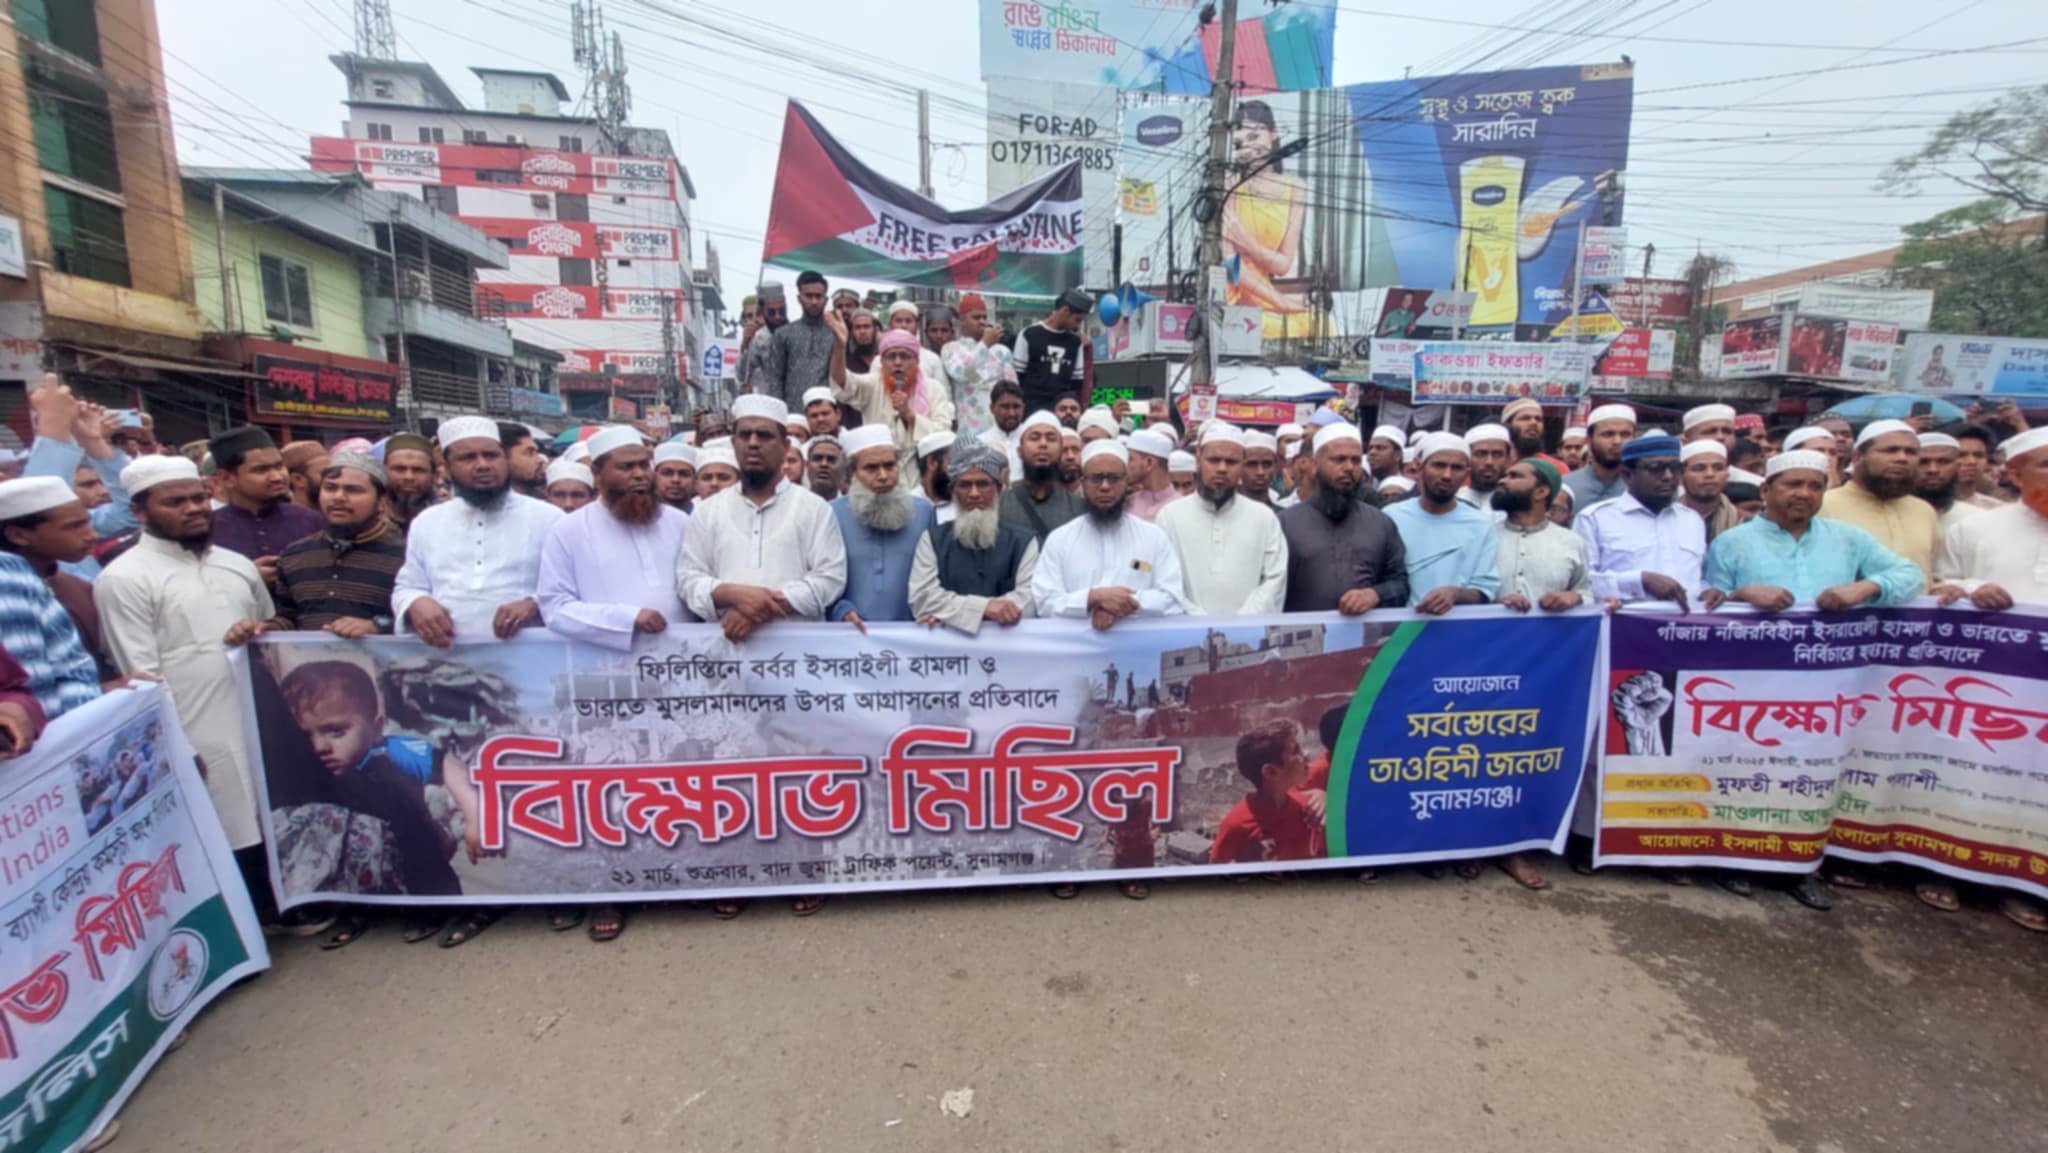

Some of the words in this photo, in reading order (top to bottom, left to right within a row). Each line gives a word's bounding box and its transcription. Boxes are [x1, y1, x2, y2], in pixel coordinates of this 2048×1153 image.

[1452, 96, 1469, 113] ও
[1475, 91, 1534, 112] সতেজ
[1539, 87, 1576, 115] ত্বক
[1019, 113, 1098, 138] FOR-AD
[1452, 112, 1536, 143] সারাদিন
[618, 162, 667, 178] PREMIER
[623, 231, 669, 246] PREMIER
[877, 211, 947, 253] FREE
[1715, 619, 1806, 642] নজিরবিহীন
[1882, 620, 1932, 638] হামলা
[1937, 622, 1954, 637] ও
[1961, 623, 2032, 645] ভারতে
[637, 653, 742, 682] ফিলিস্তিনে
[749, 652, 797, 679] বর্বর
[804, 650, 899, 680] ইসরাইলী
[908, 655, 971, 678] হামলা
[979, 655, 997, 675] ও
[1793, 643, 1855, 664] নির্বিচারে
[1907, 640, 1984, 664] প্রতিবাদে
[1432, 674, 1522, 694] আয়োজনে
[574, 698, 645, 718] ভারতে
[654, 693, 788, 720] মুসলমানদের
[794, 690, 847, 713] উপর
[853, 689, 961, 712] আগ্রাসনের
[969, 683, 1061, 711] প্রতিবাদে
[1887, 672, 2048, 753] মিছি
[1368, 743, 1481, 784] তাওহিদী
[1485, 747, 1565, 777] জনতা
[471, 735, 868, 852] বিক্ষোভ
[880, 723, 1183, 842] মিছিল
[1716, 773, 1772, 796] মুফতী
[0, 784, 65, 843] tians
[1714, 804, 1791, 824] মাওলানা
[0, 824, 71, 886] India
[1721, 831, 1782, 854] ইসলামী
[611, 869, 636, 886] ২১
[760, 862, 792, 879] বাদ
[842, 854, 897, 876] ট্রাফিক
